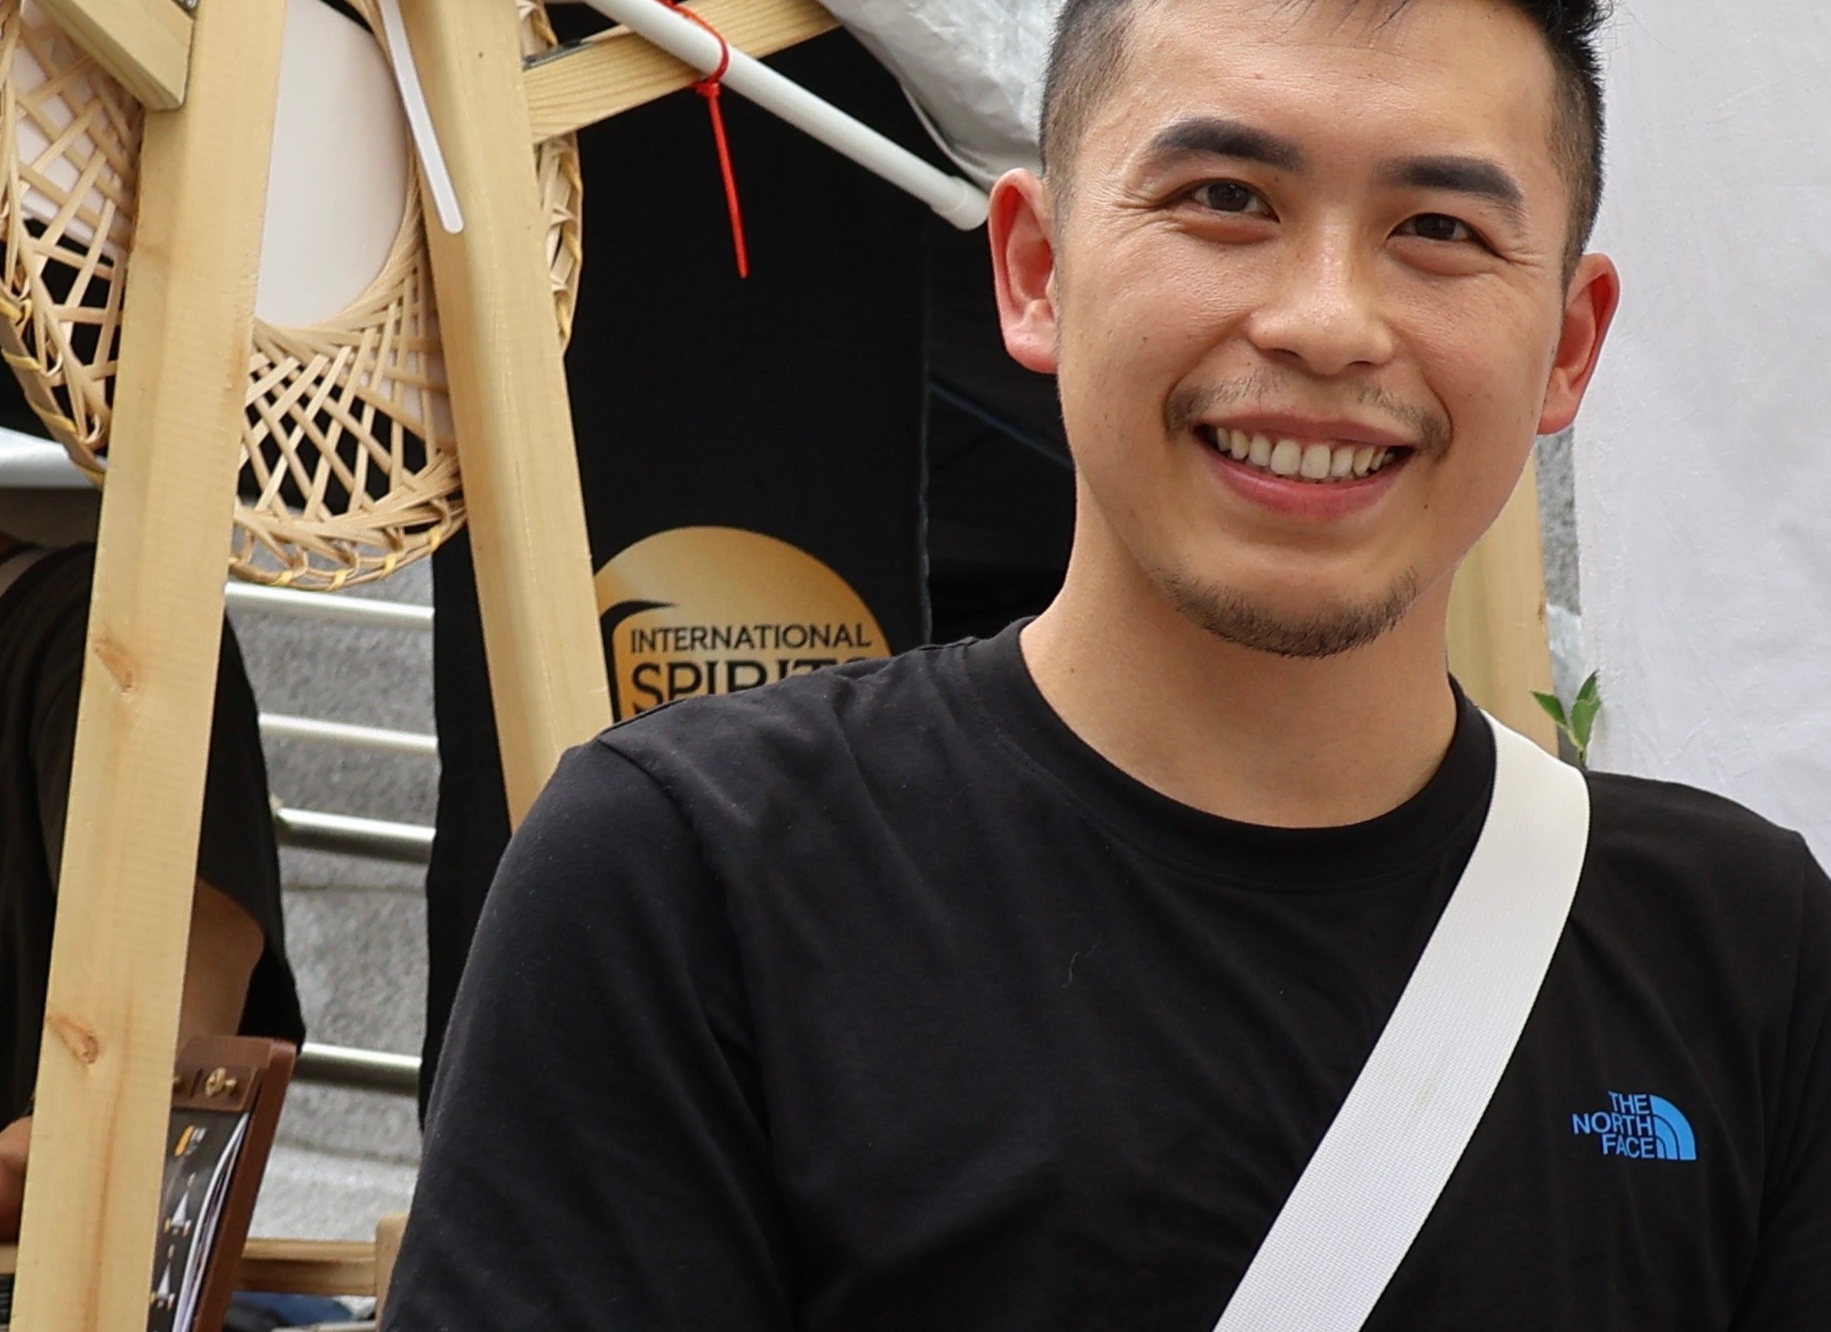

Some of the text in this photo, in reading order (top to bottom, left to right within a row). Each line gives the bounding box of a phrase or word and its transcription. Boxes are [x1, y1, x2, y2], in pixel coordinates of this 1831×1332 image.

[630, 623, 873, 654] INTERNATIONAL
[632, 658, 867, 716] SPIR
[1608, 1090, 1650, 1115] THE
[1572, 1111, 1653, 1136] NORTH
[1602, 1133, 1655, 1158] FACE
